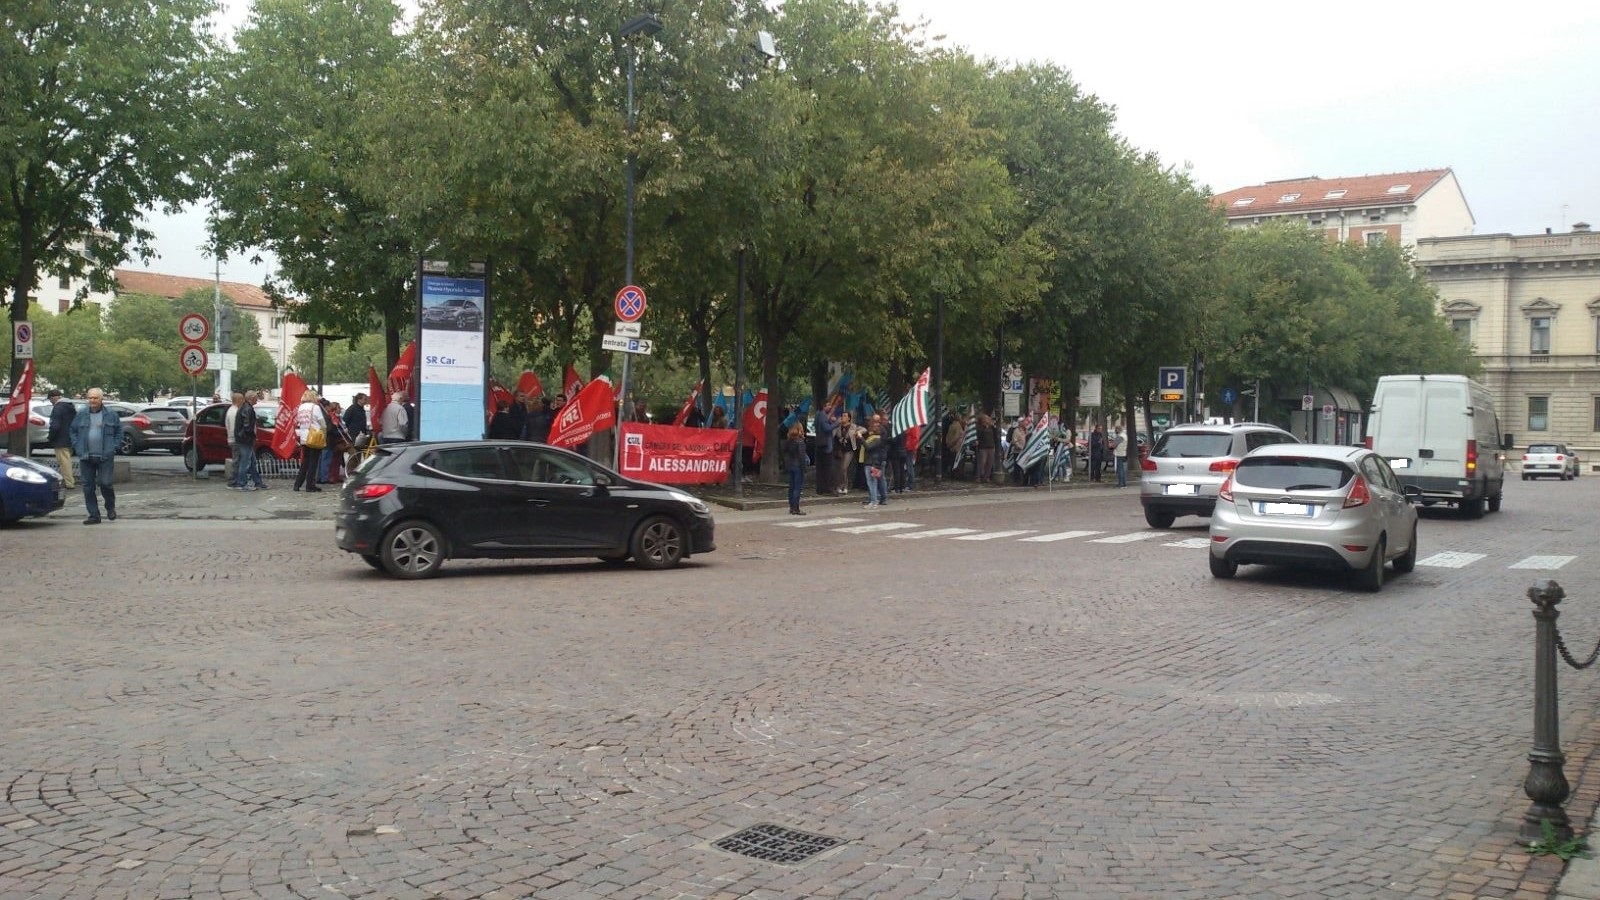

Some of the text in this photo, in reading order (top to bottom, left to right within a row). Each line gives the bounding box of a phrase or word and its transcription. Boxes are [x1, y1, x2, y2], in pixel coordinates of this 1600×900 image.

[603, 339, 637, 350] entrata P
[426, 355, 456, 365] SR Car
[1167, 372, 1179, 387] P
[649, 457, 727, 473] ALESSANDRIA
